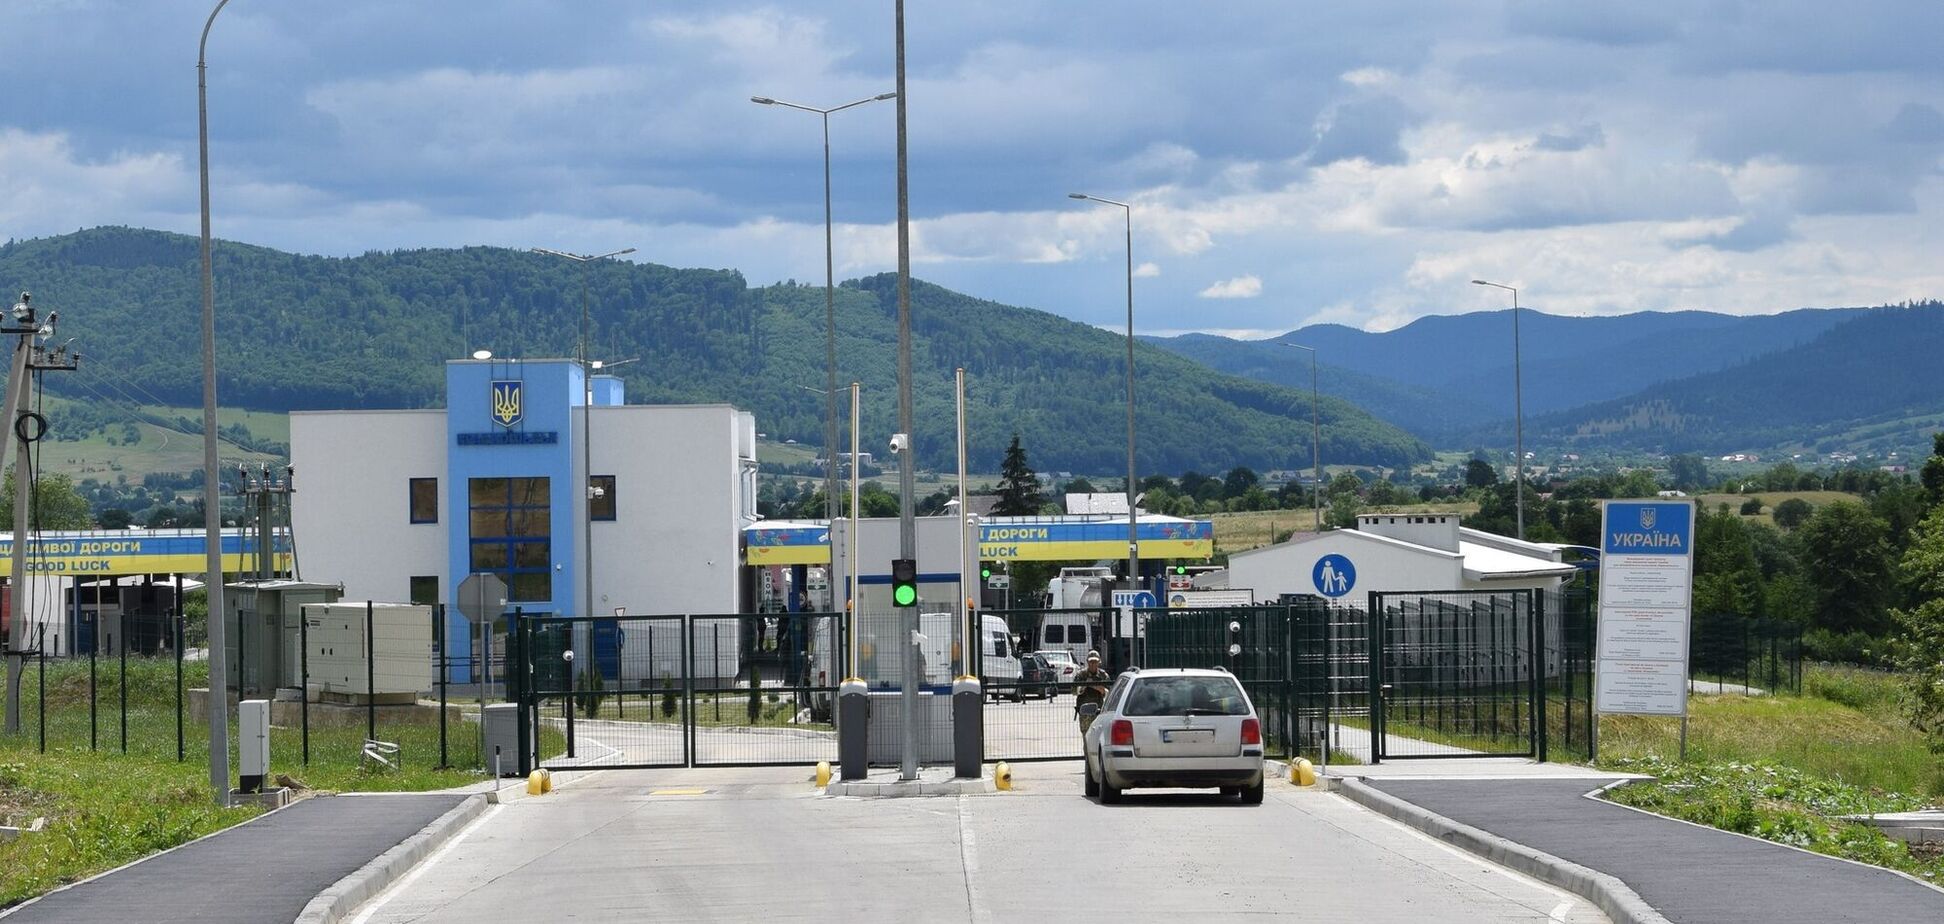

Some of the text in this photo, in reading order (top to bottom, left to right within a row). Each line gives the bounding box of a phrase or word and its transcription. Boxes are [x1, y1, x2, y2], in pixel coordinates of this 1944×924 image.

[988, 528, 1048, 541] ДОРОГИ
[1613, 530, 1682, 547] УКРАЇНА
[80, 541, 141, 555] ДОРОГИ
[980, 546, 1018, 557] LUCK
[25, 560, 111, 572] GOOD LUCK
